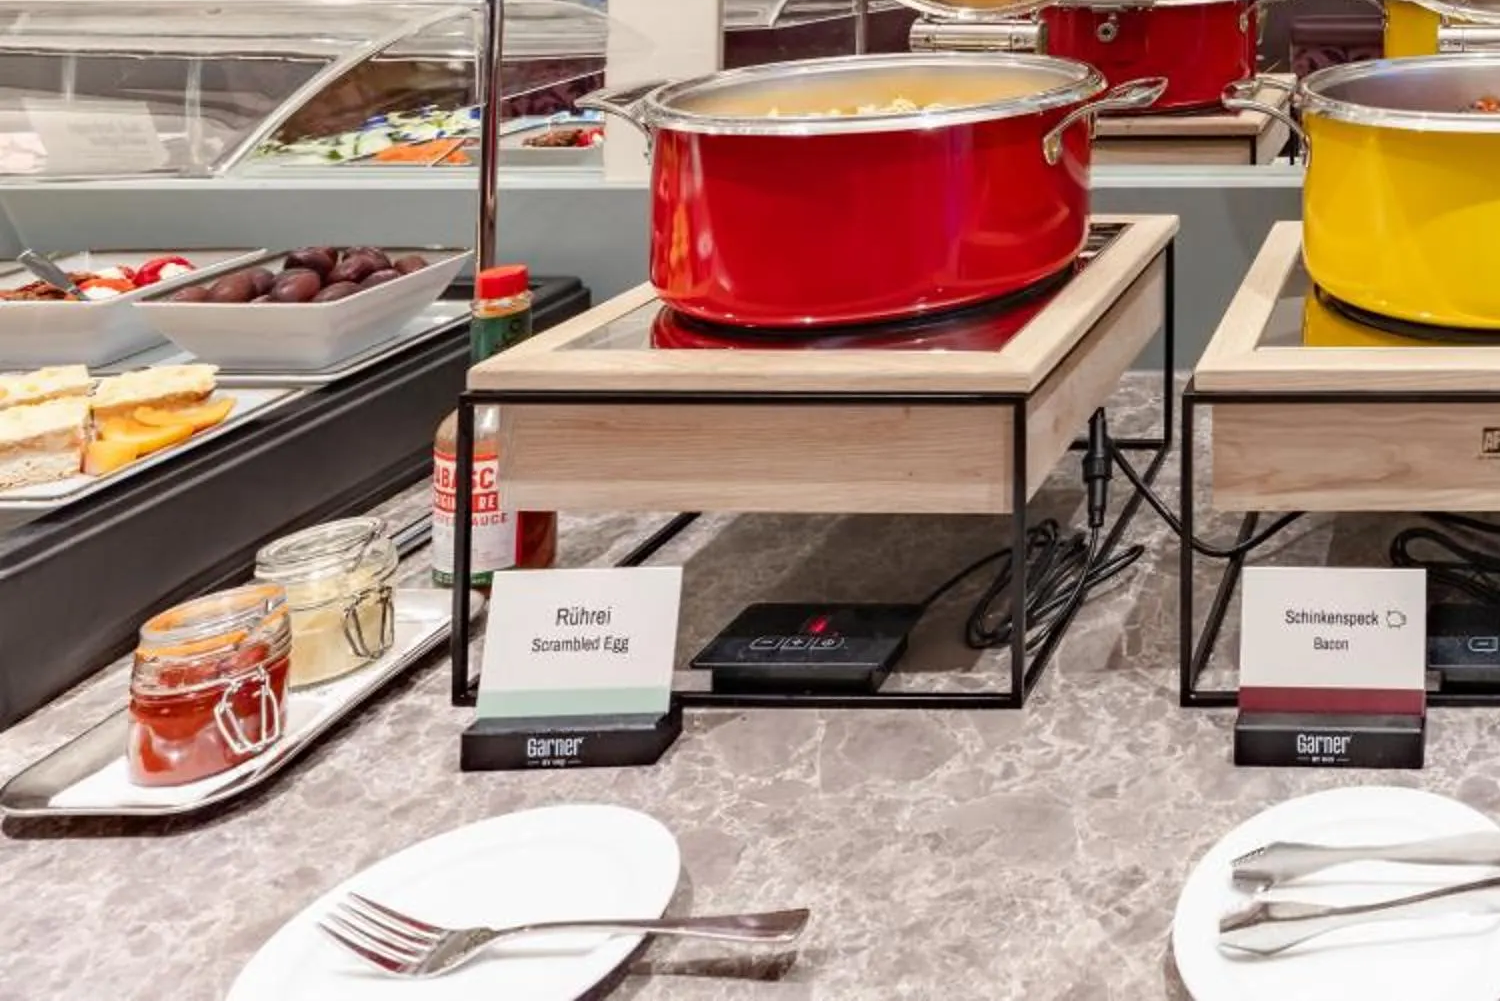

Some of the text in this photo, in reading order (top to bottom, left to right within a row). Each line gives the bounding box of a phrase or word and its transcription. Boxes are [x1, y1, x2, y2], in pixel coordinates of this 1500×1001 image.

[555, 605, 612, 626] Rührei
[1284, 608, 1379, 628] Schinkenspeck
[531, 635, 629, 654] Scrambled Egg
[1313, 636, 1349, 650] Bacon
[527, 737, 584, 758] Garner
[1297, 734, 1352, 754] Garner
